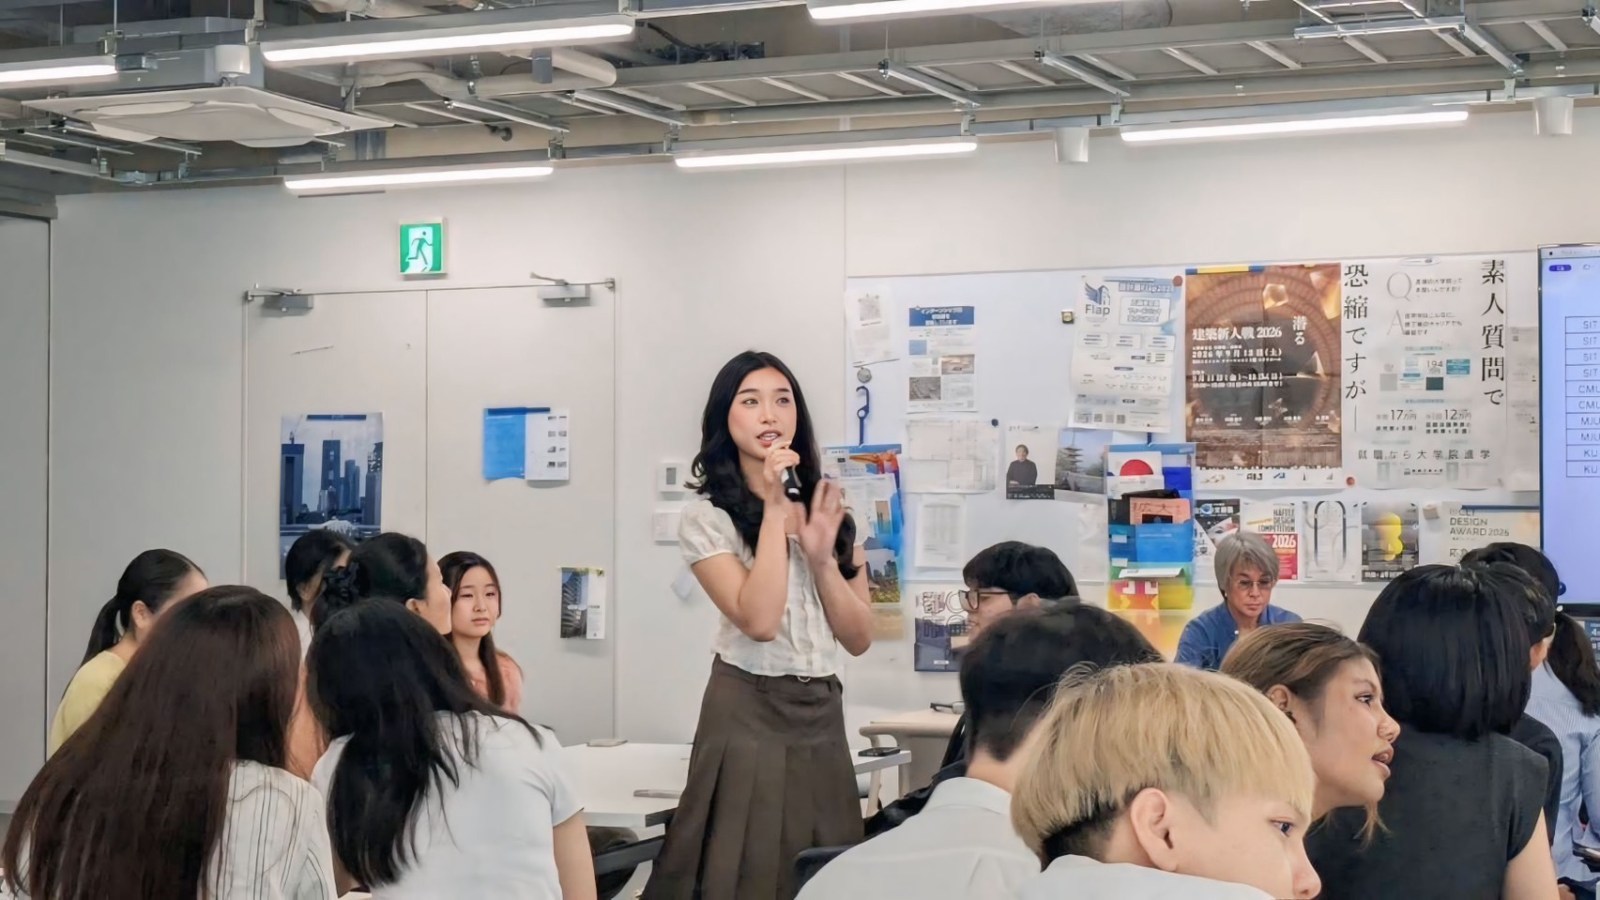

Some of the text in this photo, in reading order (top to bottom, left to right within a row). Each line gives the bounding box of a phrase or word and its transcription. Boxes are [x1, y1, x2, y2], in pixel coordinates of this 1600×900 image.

[1386, 271, 1412, 302] Q
[1085, 304, 1111, 317] Flap
[1583, 320, 1598, 330] SIT
[1256, 326, 1283, 338] 2026
[1292, 315, 1308, 346] 潜る
[1481, 259, 1505, 406] 素人質問で
[1583, 336, 1598, 346] SIT
[1583, 352, 1598, 362] SIT
[1583, 368, 1599, 378] SIT
[1583, 449, 1598, 458] KU
[1583, 465, 1598, 474] KU
[1449, 517, 1488, 526] DESIGN
[1449, 527, 1487, 536] AWARD
[1272, 534, 1297, 548] 2026
